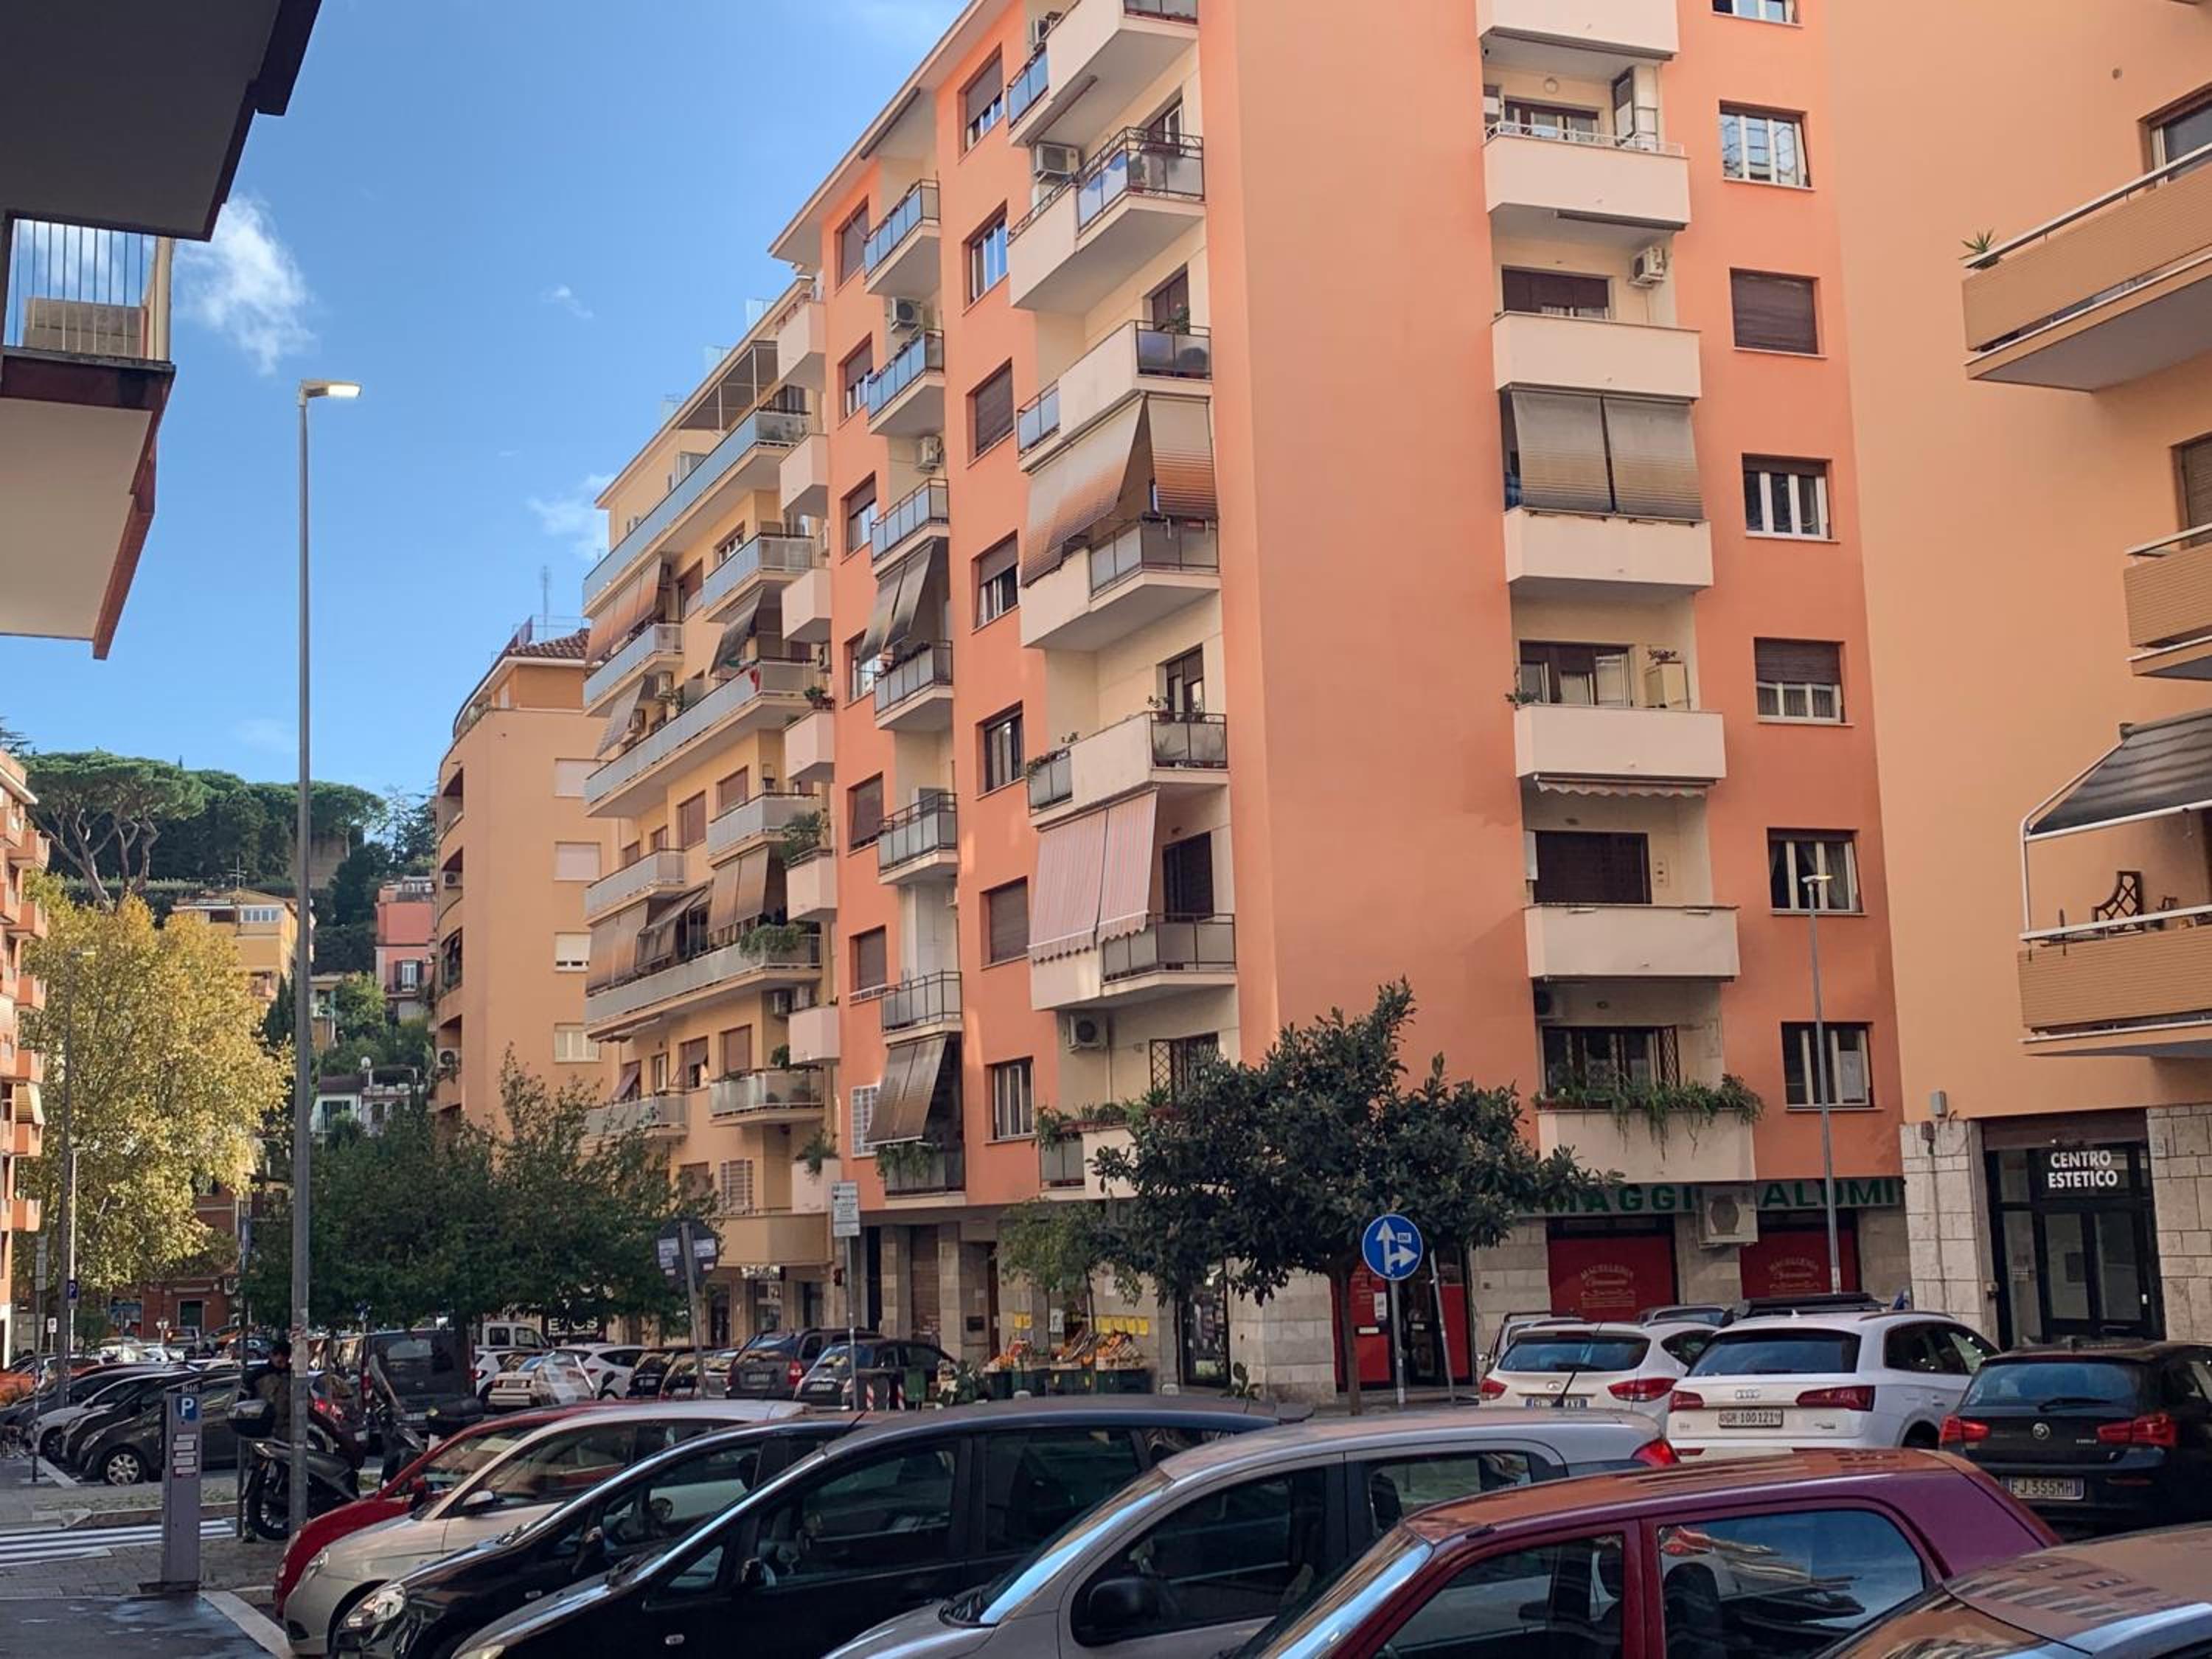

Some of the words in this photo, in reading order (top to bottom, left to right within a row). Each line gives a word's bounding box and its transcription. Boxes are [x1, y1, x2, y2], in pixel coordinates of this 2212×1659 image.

[2051, 1150, 2112, 1168] CENTRO
[2048, 1170, 2118, 1189] ESTETICO
[1761, 1179, 1896, 1207] ALUMI
[181, 1397, 195, 1416] P
